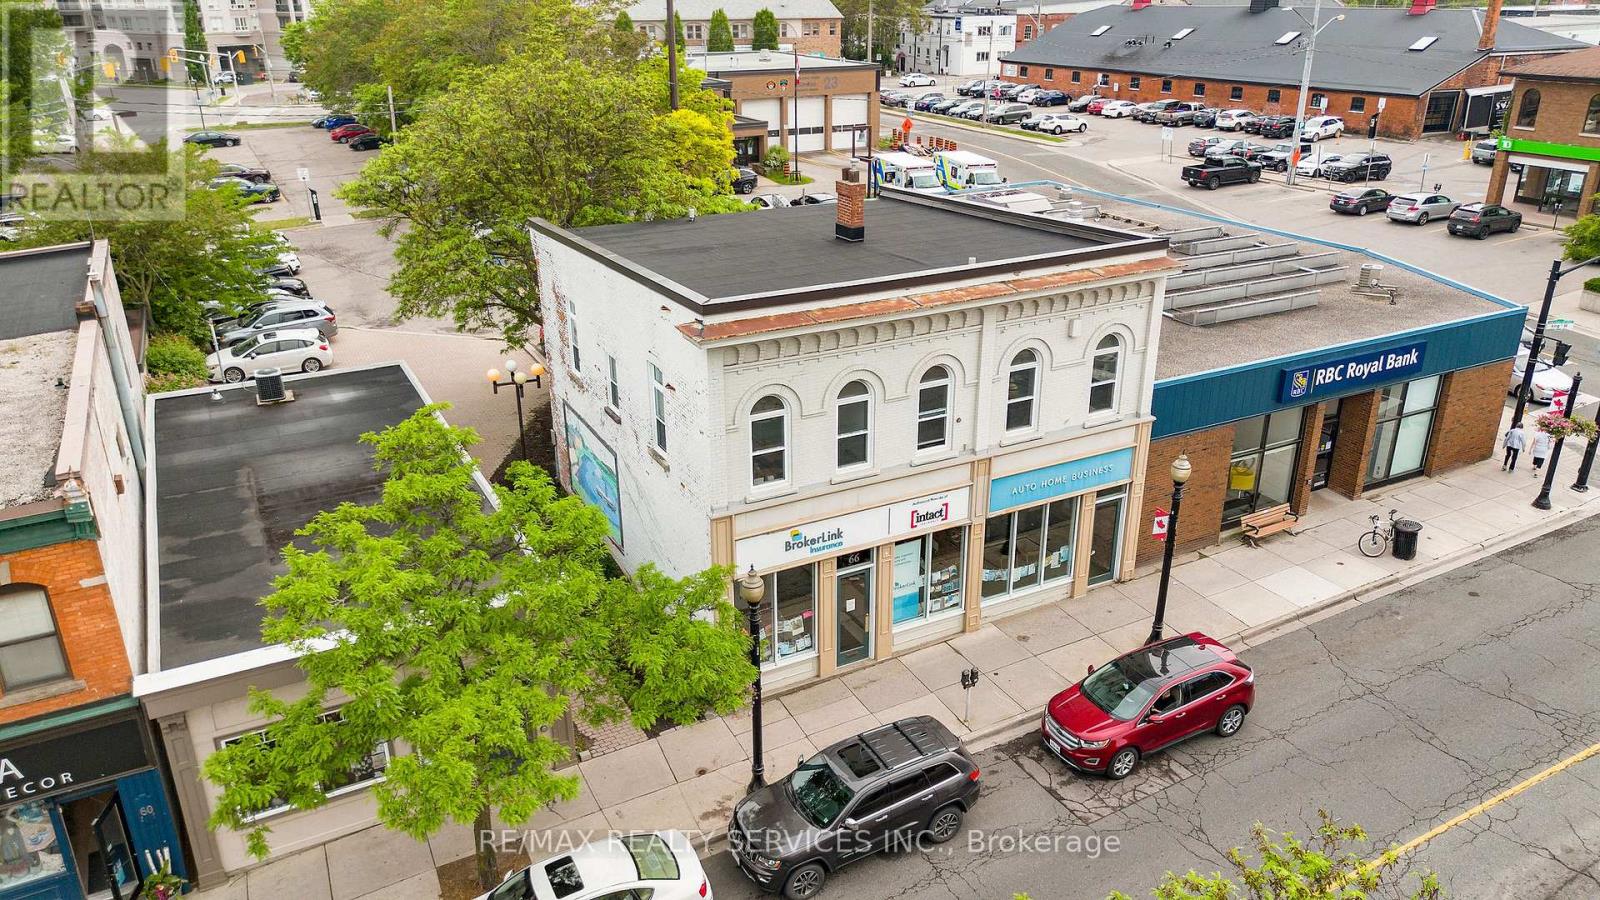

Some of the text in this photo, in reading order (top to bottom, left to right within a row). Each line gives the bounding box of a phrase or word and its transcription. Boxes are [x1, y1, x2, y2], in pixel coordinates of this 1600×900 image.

[1315, 348, 1419, 386] RBC Royal Bank
[1011, 464, 1113, 495] AUTO HOME BUSINESS
[784, 528, 843, 552] BrokerLink
[848, 553, 860, 563] 66
